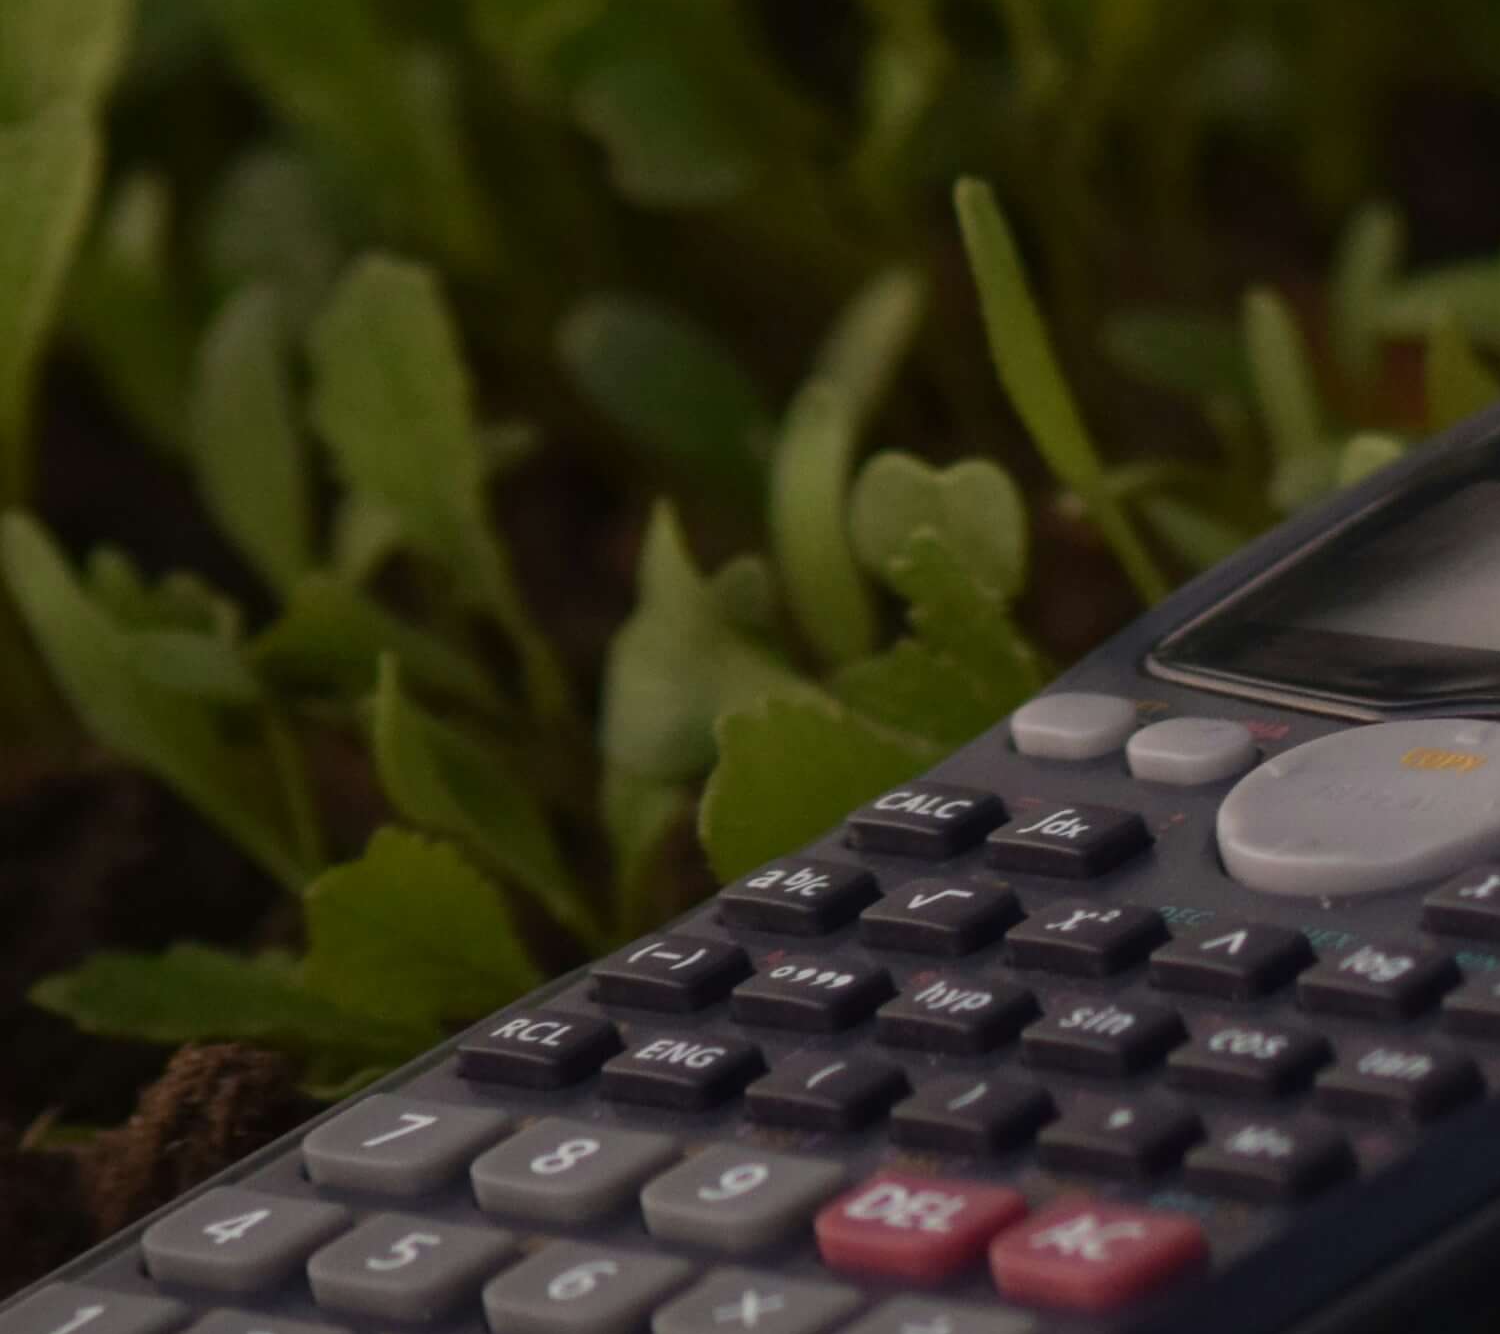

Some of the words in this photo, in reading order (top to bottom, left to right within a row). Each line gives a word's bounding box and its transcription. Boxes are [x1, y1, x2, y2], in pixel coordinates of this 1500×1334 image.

[873, 792, 974, 820] CALC
[1339, 946, 1414, 982] log
[914, 980, 994, 1013] hyp
[490, 1018, 576, 1047] RCL
[1058, 1006, 1136, 1036] sin
[634, 1038, 726, 1068] ENG
[1208, 1029, 1288, 1060] cos
[363, 1113, 439, 1151] 7
[530, 1138, 600, 1175] 8
[698, 1162, 769, 1201] 9
[846, 1181, 967, 1233] DEL
[203, 1208, 273, 1245] 4
[1029, 1213, 1146, 1262] AC
[364, 1233, 441, 1270] 5
[547, 1259, 619, 1301] 6
